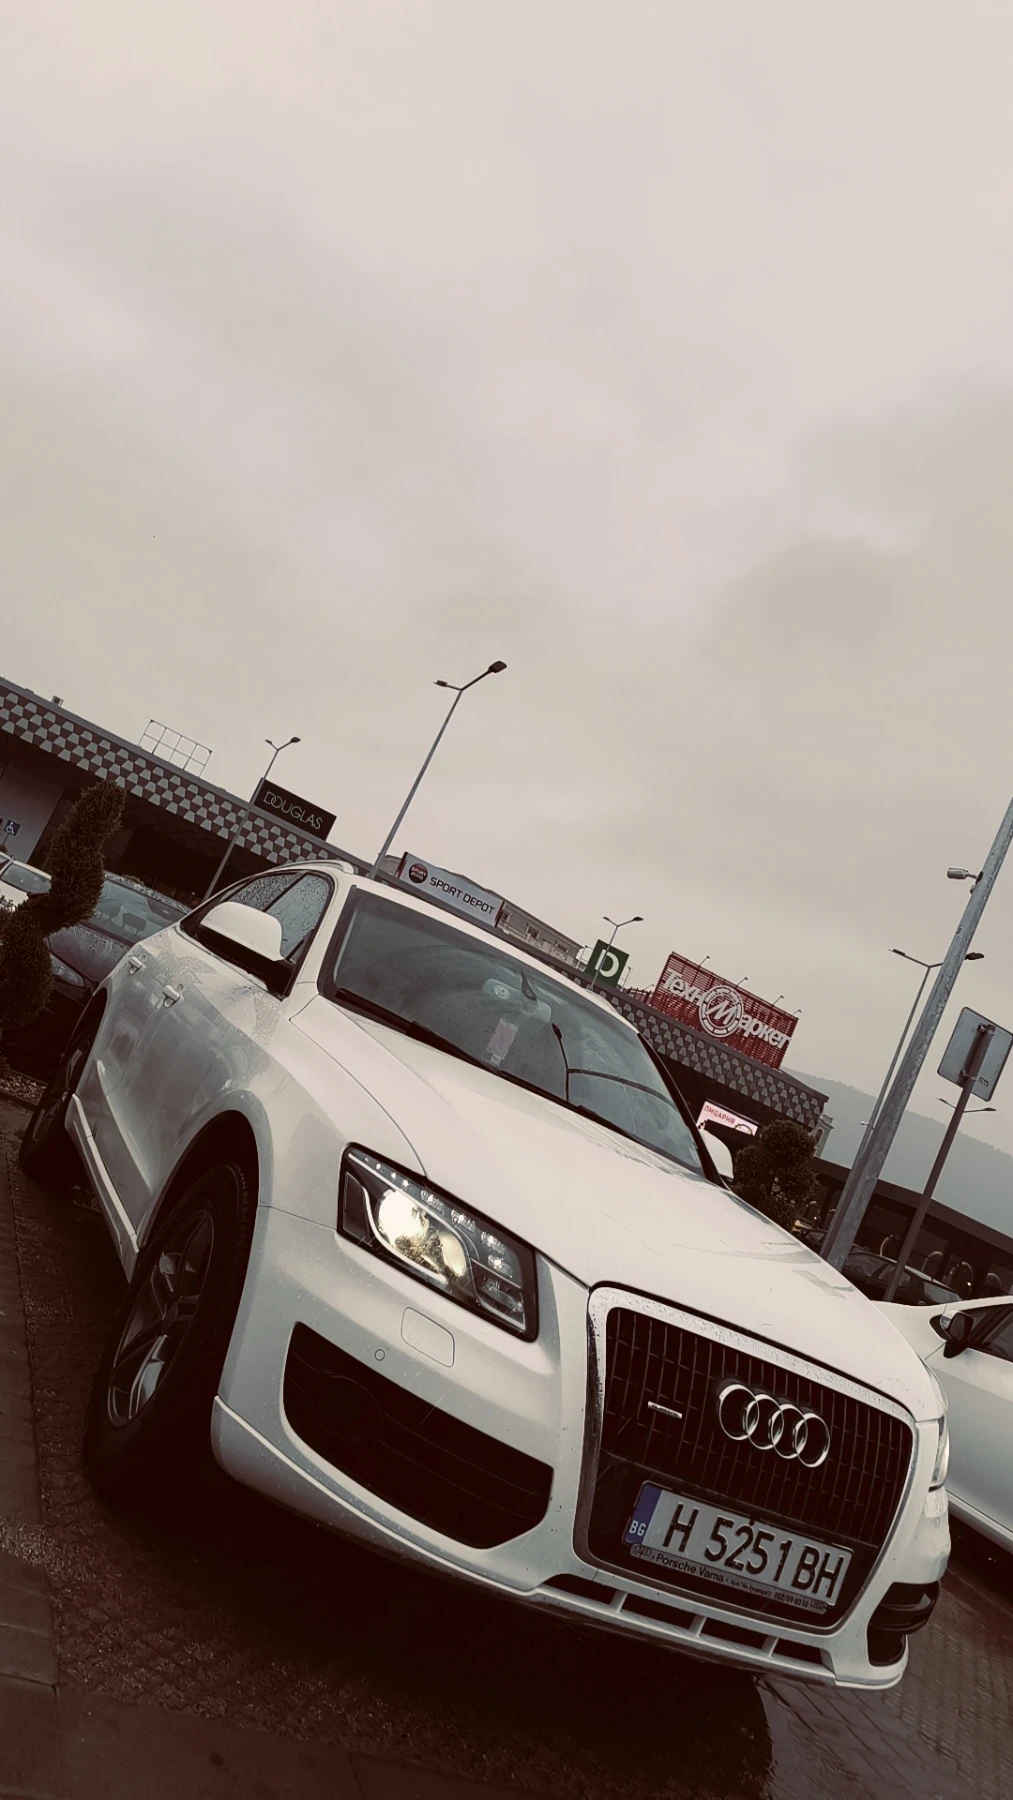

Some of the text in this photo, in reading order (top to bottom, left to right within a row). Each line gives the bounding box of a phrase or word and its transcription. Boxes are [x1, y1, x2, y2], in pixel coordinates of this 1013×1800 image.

[263, 791, 323, 830] DOUGLAS
[429, 876, 495, 915] SPORT DEPOT
[595, 949, 620, 978] D
[704, 1105, 736, 1125] ПИЦАРИЯ
[629, 1520, 646, 1536] BG
[662, 1502, 844, 1599] H 5251 BH
[656, 1553, 696, 1574] Porsche
[699, 1566, 724, 1583] Varna
